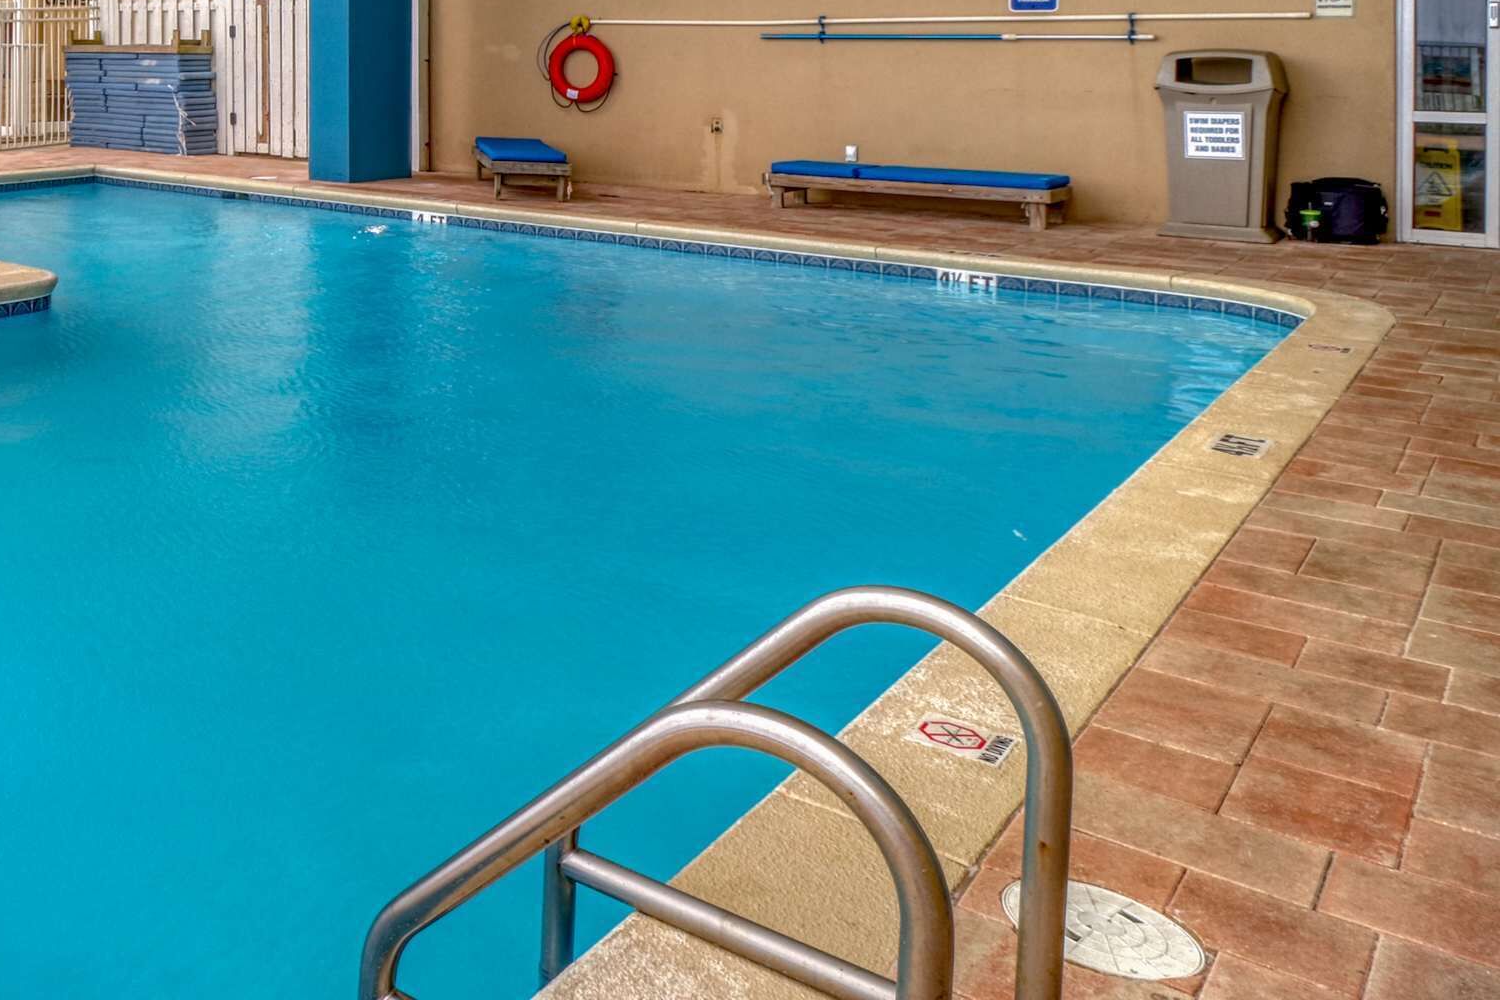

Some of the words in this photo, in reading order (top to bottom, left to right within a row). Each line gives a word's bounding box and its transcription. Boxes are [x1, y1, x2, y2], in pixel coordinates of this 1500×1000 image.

[1188, 117, 1209, 125] SWIM
[1210, 117, 1240, 126] DIAPERS
[1225, 127, 1239, 135] FOR
[1205, 136, 1240, 144] TODDLERS
[1194, 145, 1209, 153] AND
[1211, 145, 1236, 153] BABIES
